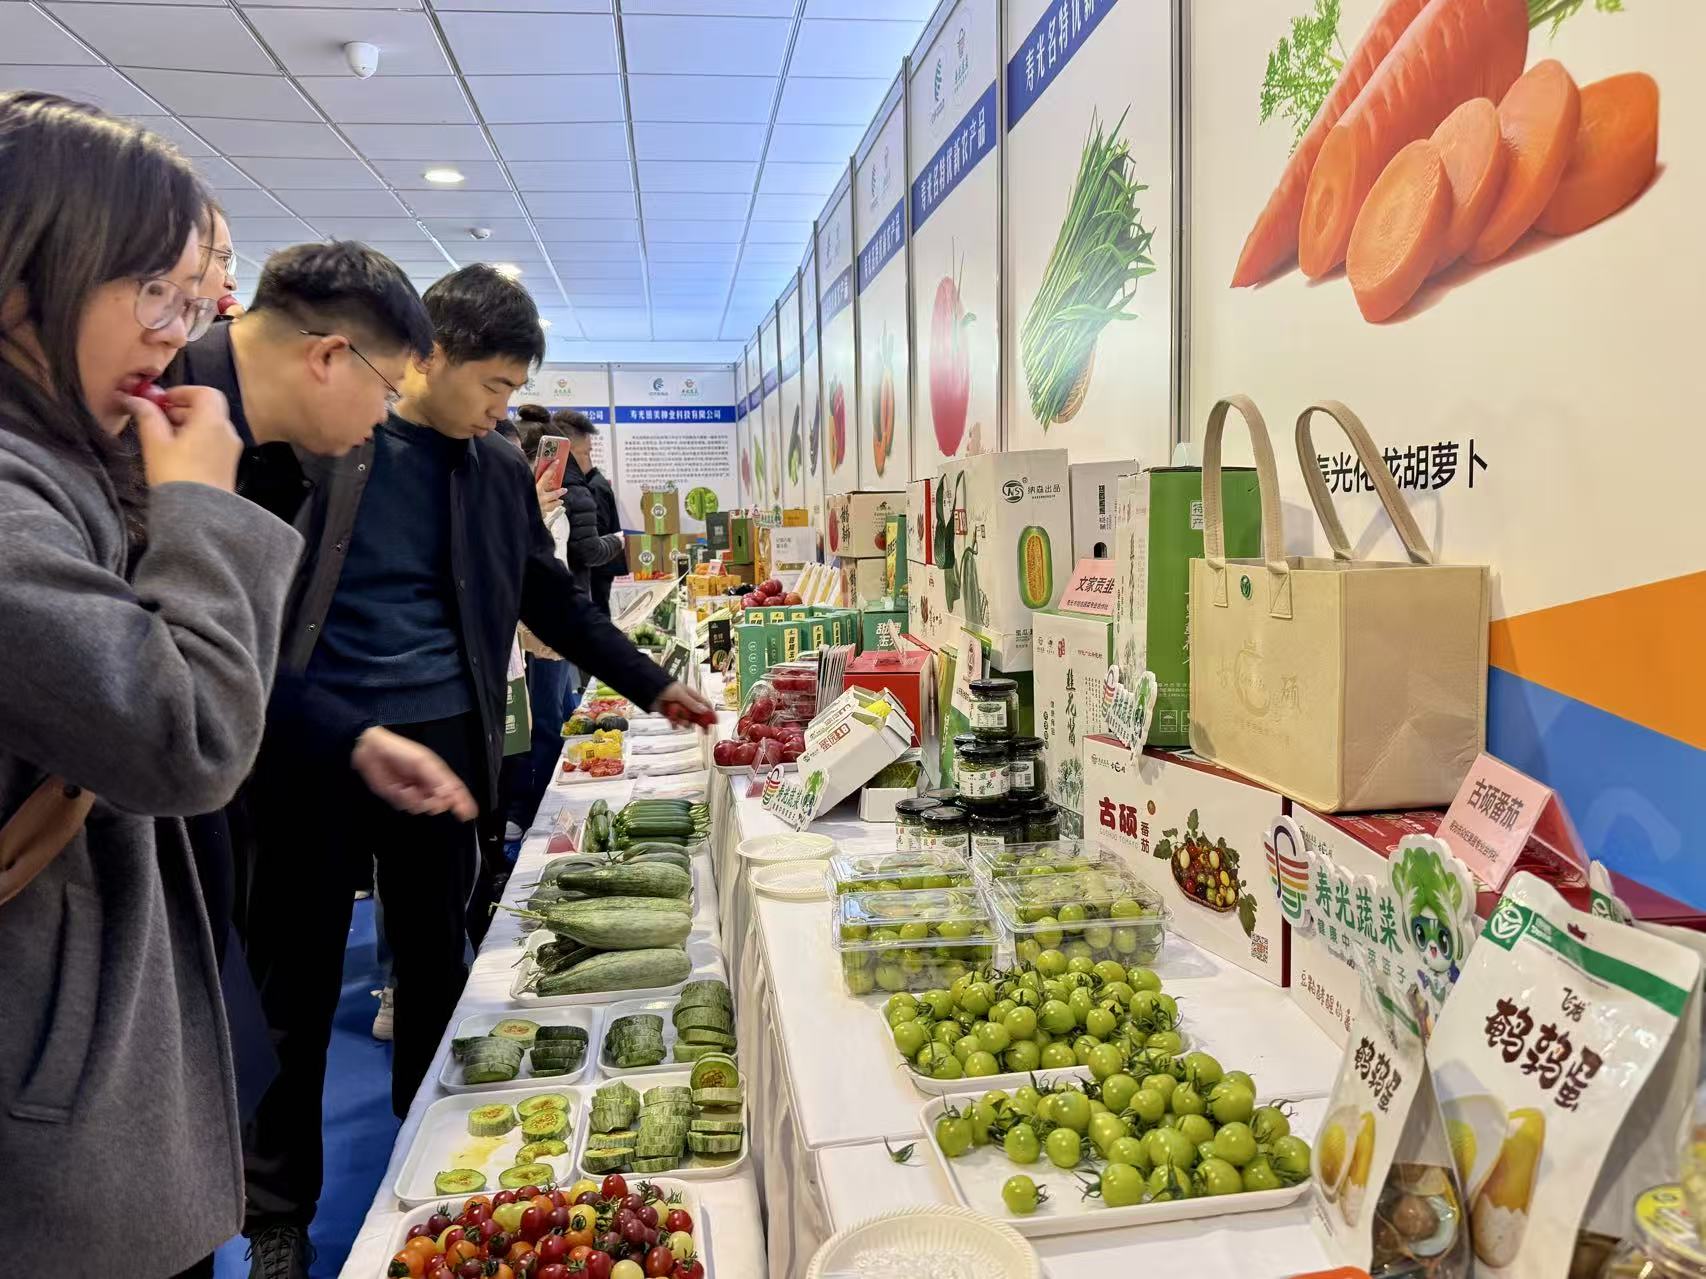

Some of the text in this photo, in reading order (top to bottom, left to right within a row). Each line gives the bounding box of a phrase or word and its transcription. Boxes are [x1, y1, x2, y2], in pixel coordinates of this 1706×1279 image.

[921, 106, 986, 211] 寿光名特优新农产品
[1075, 575, 1115, 595] 文家贡韭
[1098, 796, 1138, 840] 古硕
[1140, 821, 1150, 854] 番茄
[1466, 777, 1525, 833] 古硕番茄
[1315, 865, 1404, 954] 寿光蔬菜
[1317, 918, 1407, 985] 健康中菜篮子
[1353, 1035, 1403, 1115] 鹌鹑蛋
[1484, 996, 1604, 1113] 鹌鹑蛋
